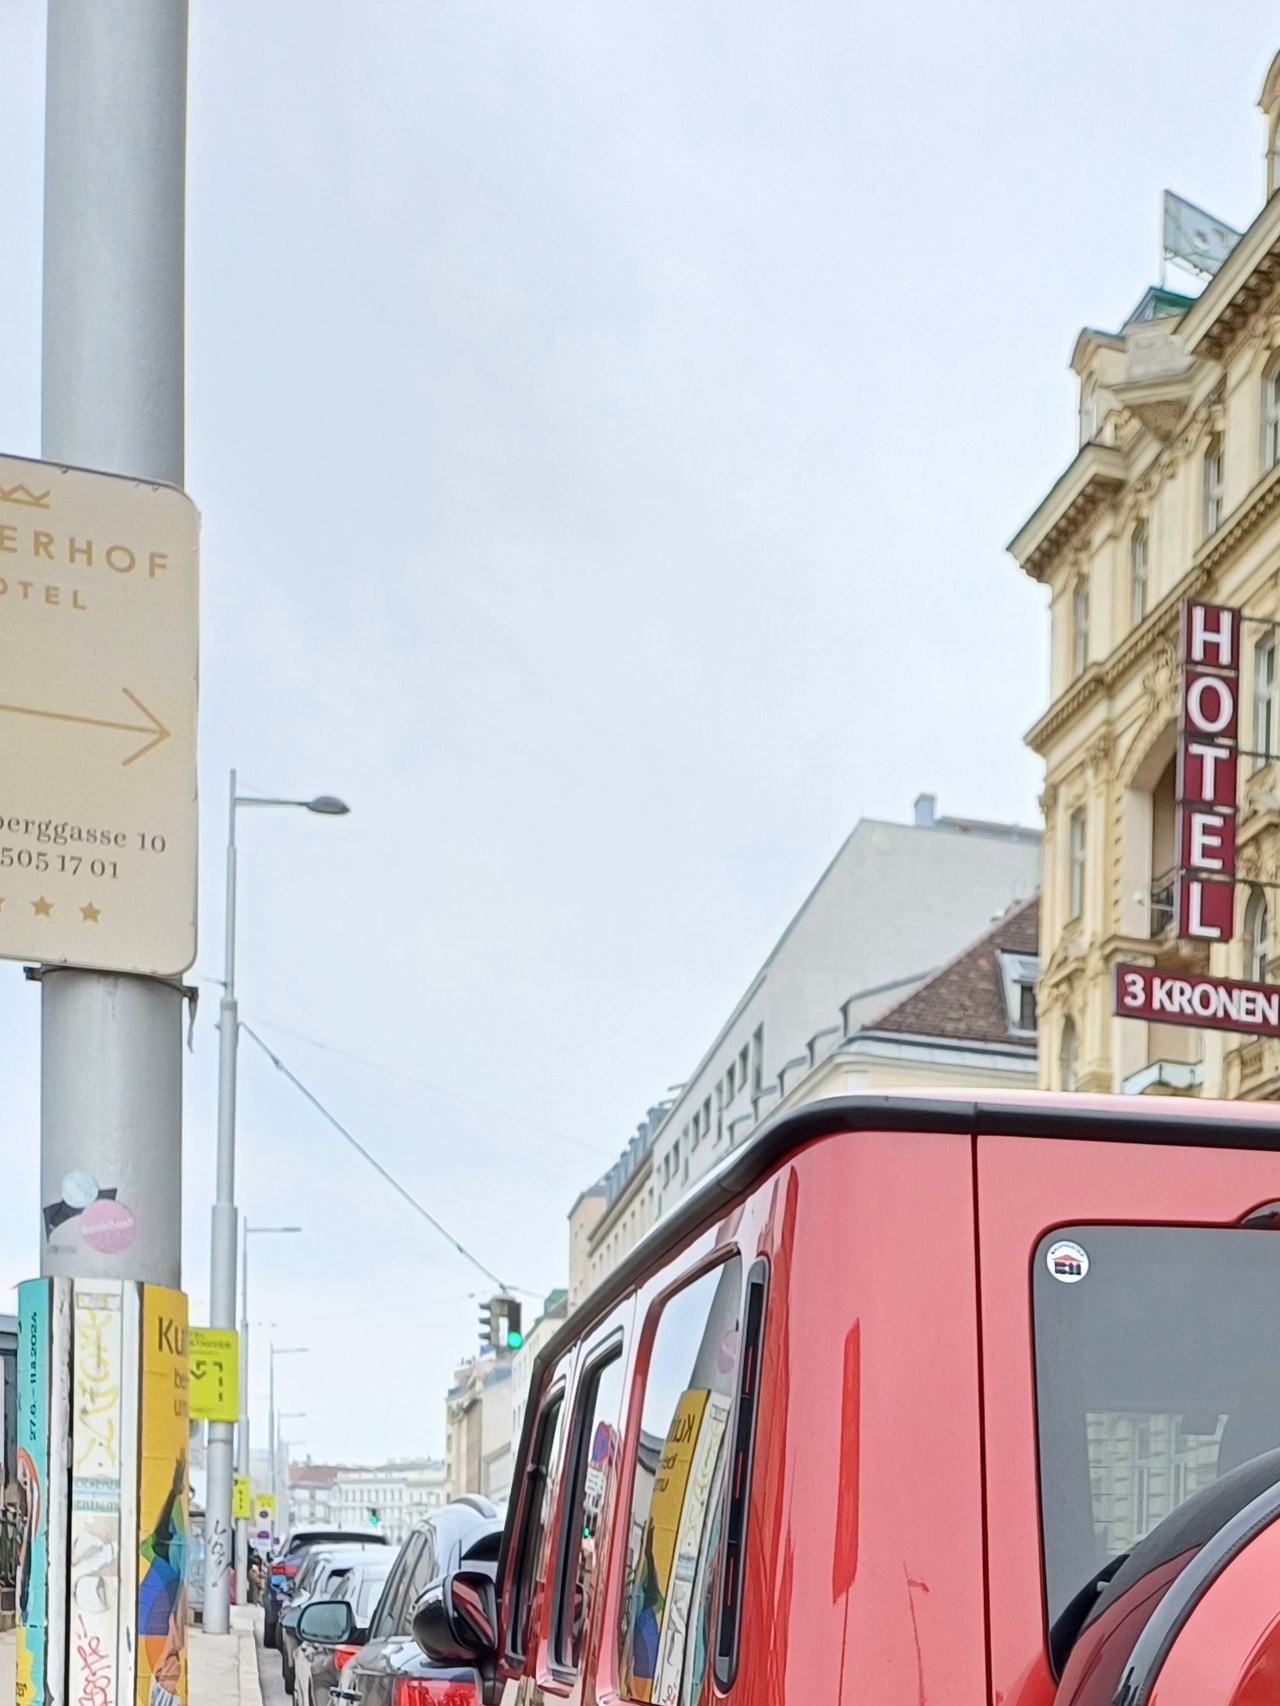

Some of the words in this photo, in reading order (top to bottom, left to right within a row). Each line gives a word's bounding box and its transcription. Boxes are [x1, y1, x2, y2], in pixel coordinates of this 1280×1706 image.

[0, 524, 169, 579] ERHOF
[1187, 605, 1234, 938] HOTEL
[0, 814, 127, 848] erggasse
[137, 832, 166, 853] 10
[0, 847, 49, 872] 505
[57, 854, 83, 876] 17
[90, 859, 119, 880] 01
[1123, 973, 1146, 1008] 3
[1152, 977, 1279, 1026] KRONEN
